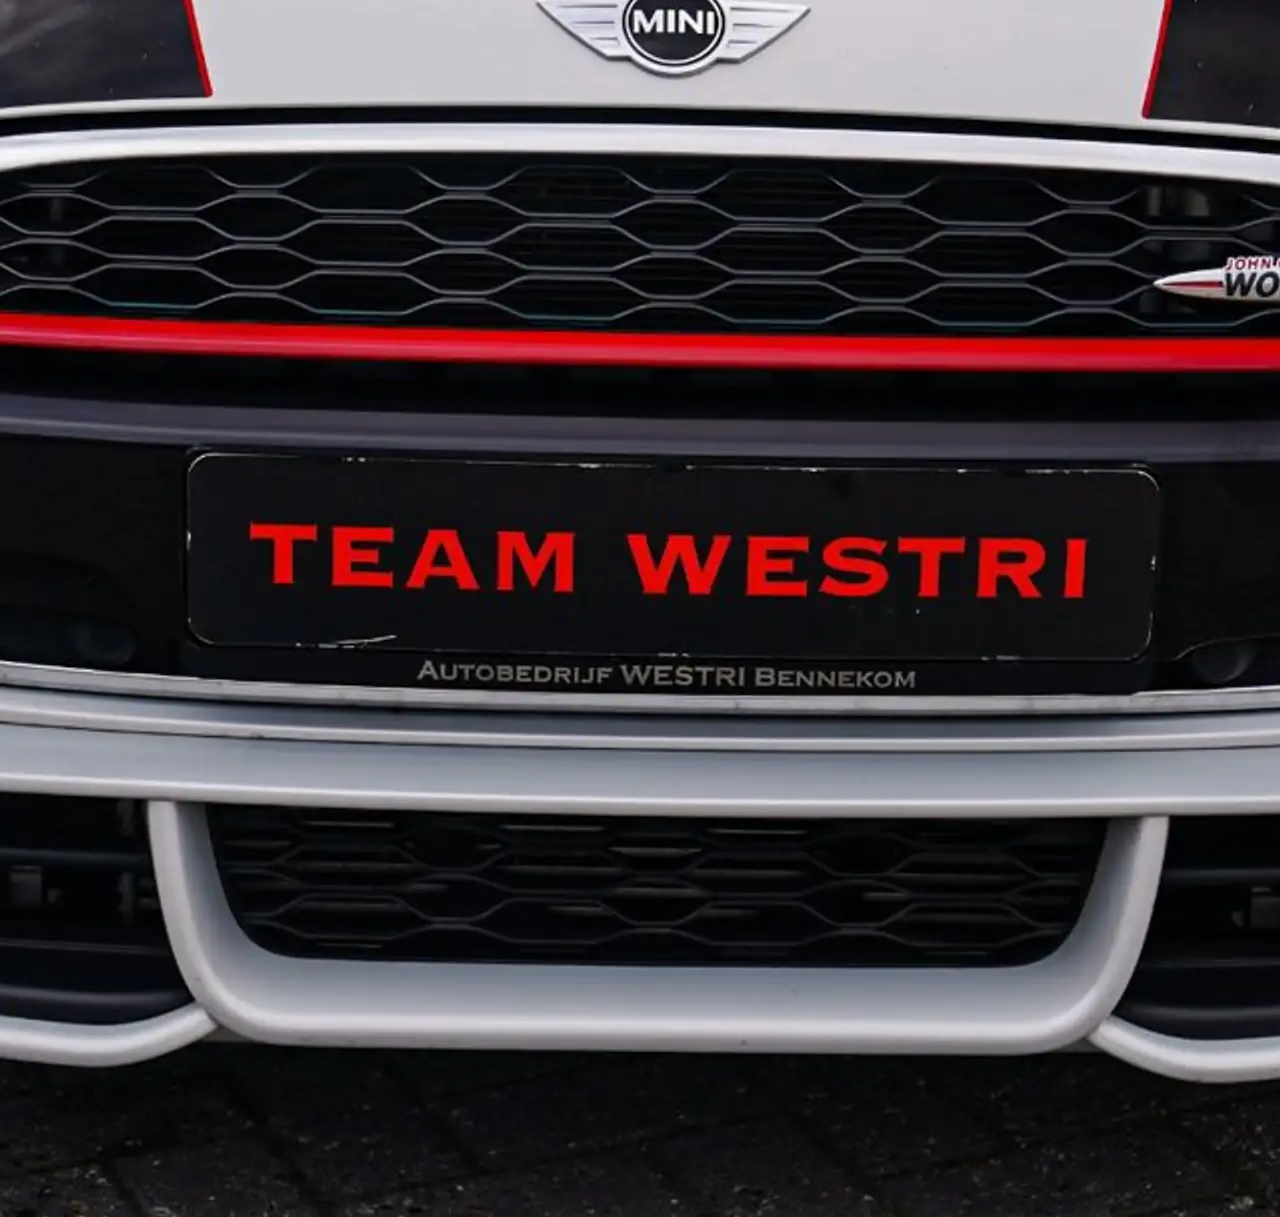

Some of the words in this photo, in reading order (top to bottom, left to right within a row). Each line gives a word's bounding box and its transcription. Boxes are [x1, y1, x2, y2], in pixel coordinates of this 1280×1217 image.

[633, 9, 715, 34] MINI
[1224, 256, 1273, 270] JOHN
[250, 524, 574, 592] TEAM
[627, 534, 1086, 598] WESTRI
[620, 664, 745, 687] WESTRI
